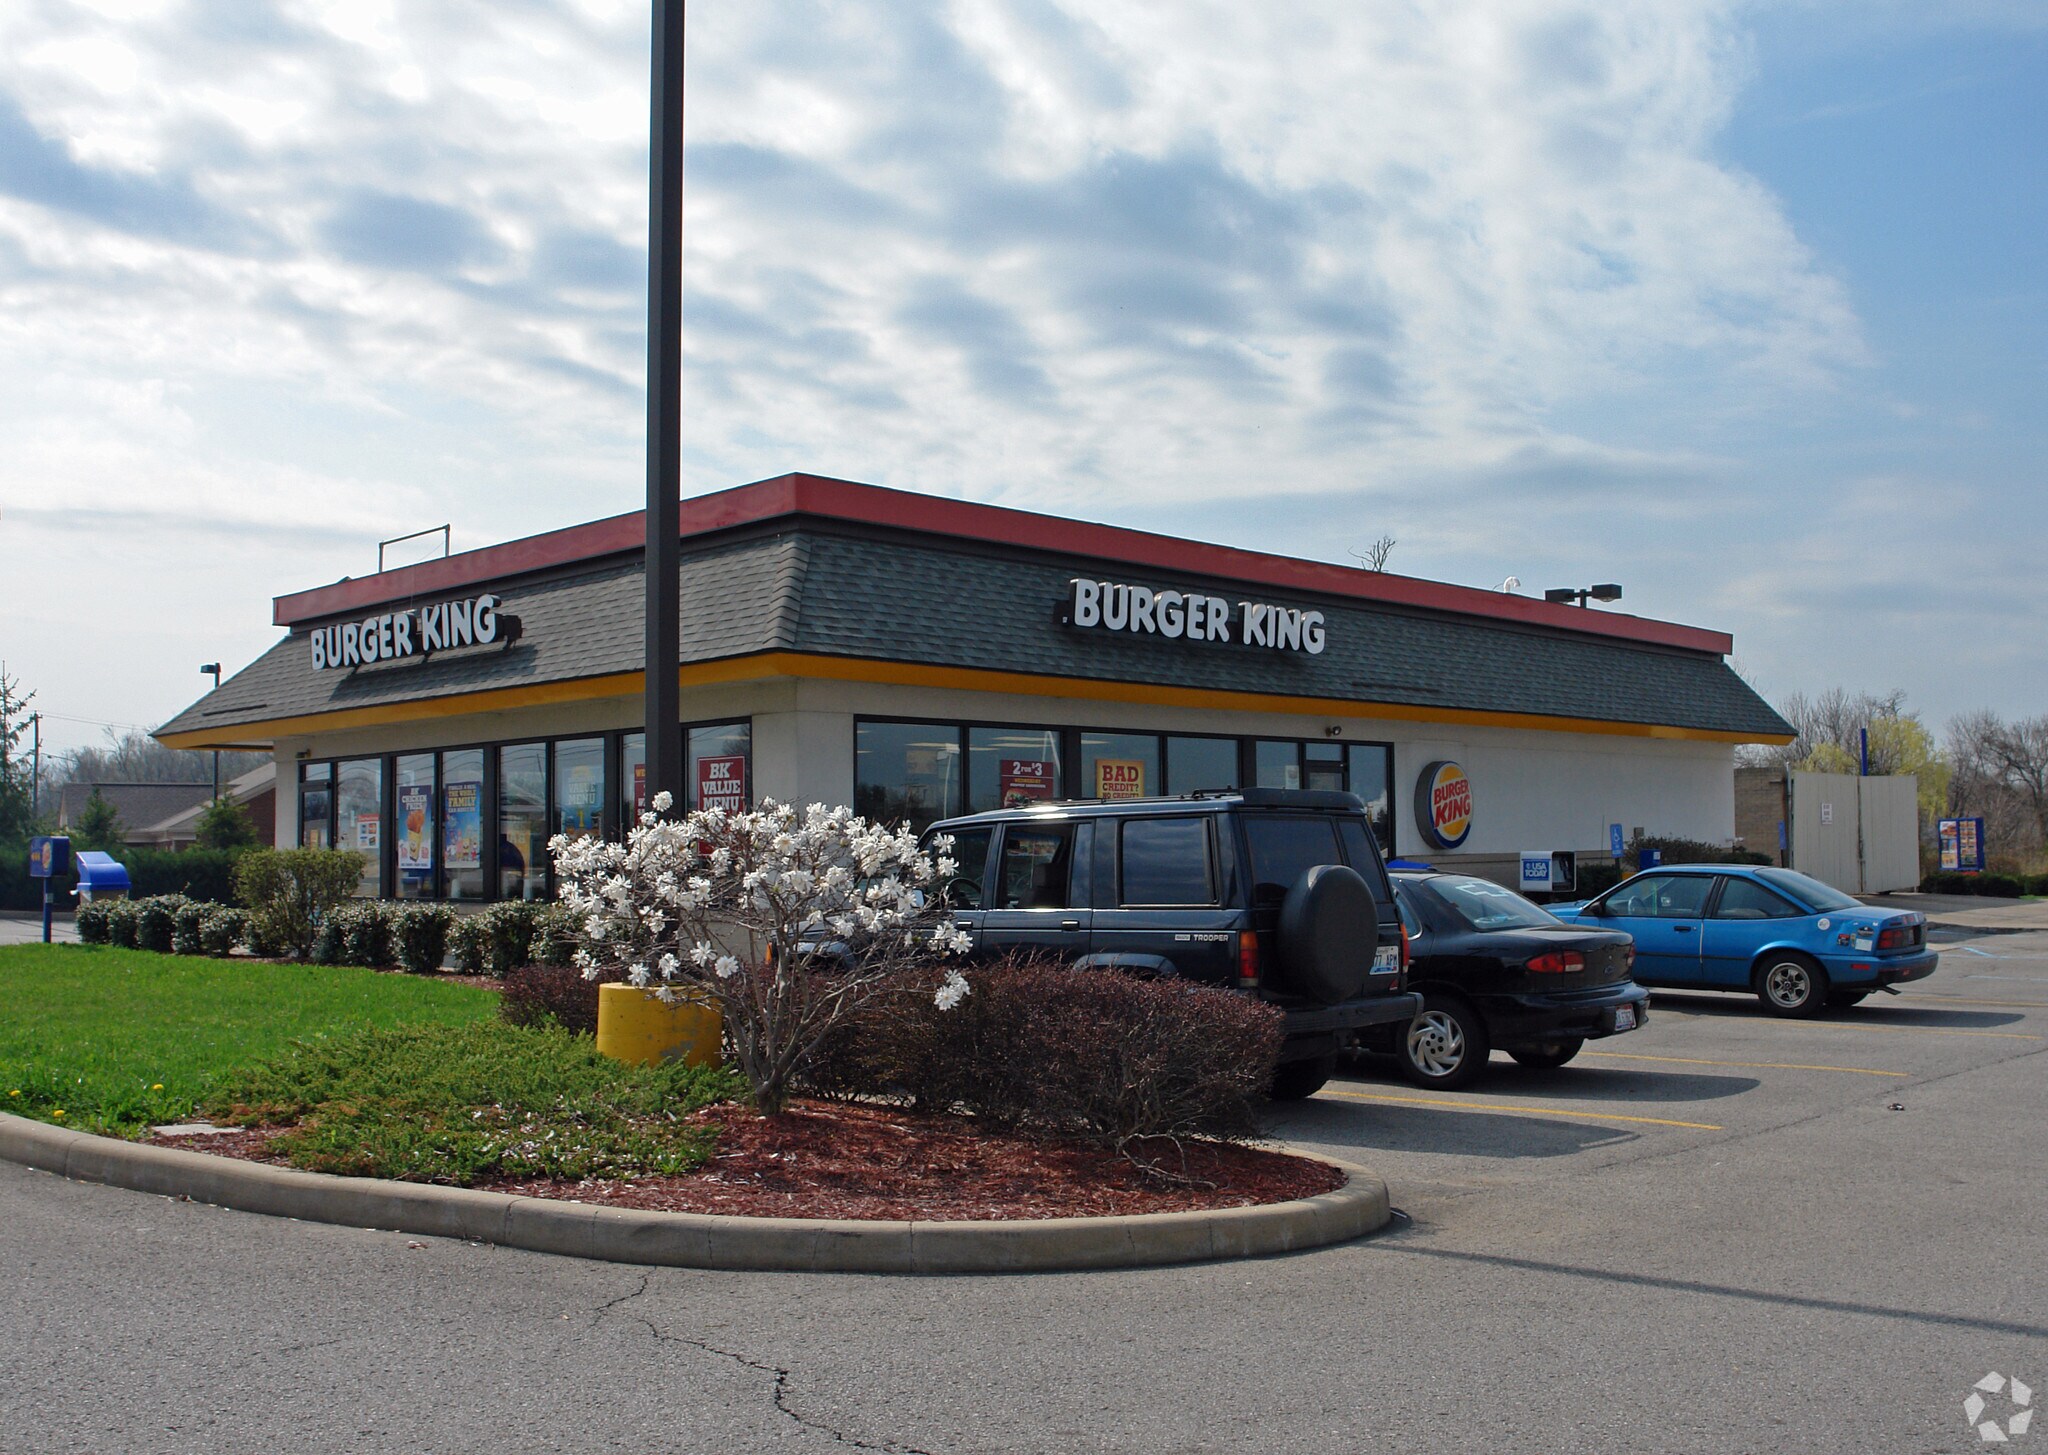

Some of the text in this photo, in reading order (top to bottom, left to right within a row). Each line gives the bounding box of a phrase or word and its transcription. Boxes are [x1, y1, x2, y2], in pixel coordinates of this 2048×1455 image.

[1073, 578, 1326, 655] BURGER KING
[310, 593, 497, 671] BURGER KING
[709, 762, 731, 779] BK
[1013, 761, 1021, 774] 2
[1032, 762, 1043, 776] $3
[1102, 765, 1139, 782] BAD
[568, 783, 596, 793] VALUE
[701, 780, 741, 795] VALUE
[1102, 782, 1139, 792] CREDIT?
[1433, 779, 1470, 805] BURGER
[448, 797, 476, 808] FAMILY
[568, 793, 596, 805] MENU
[702, 796, 740, 811] MENU
[1435, 794, 1471, 828] KING
[1525, 869, 1548, 877] TODAY
